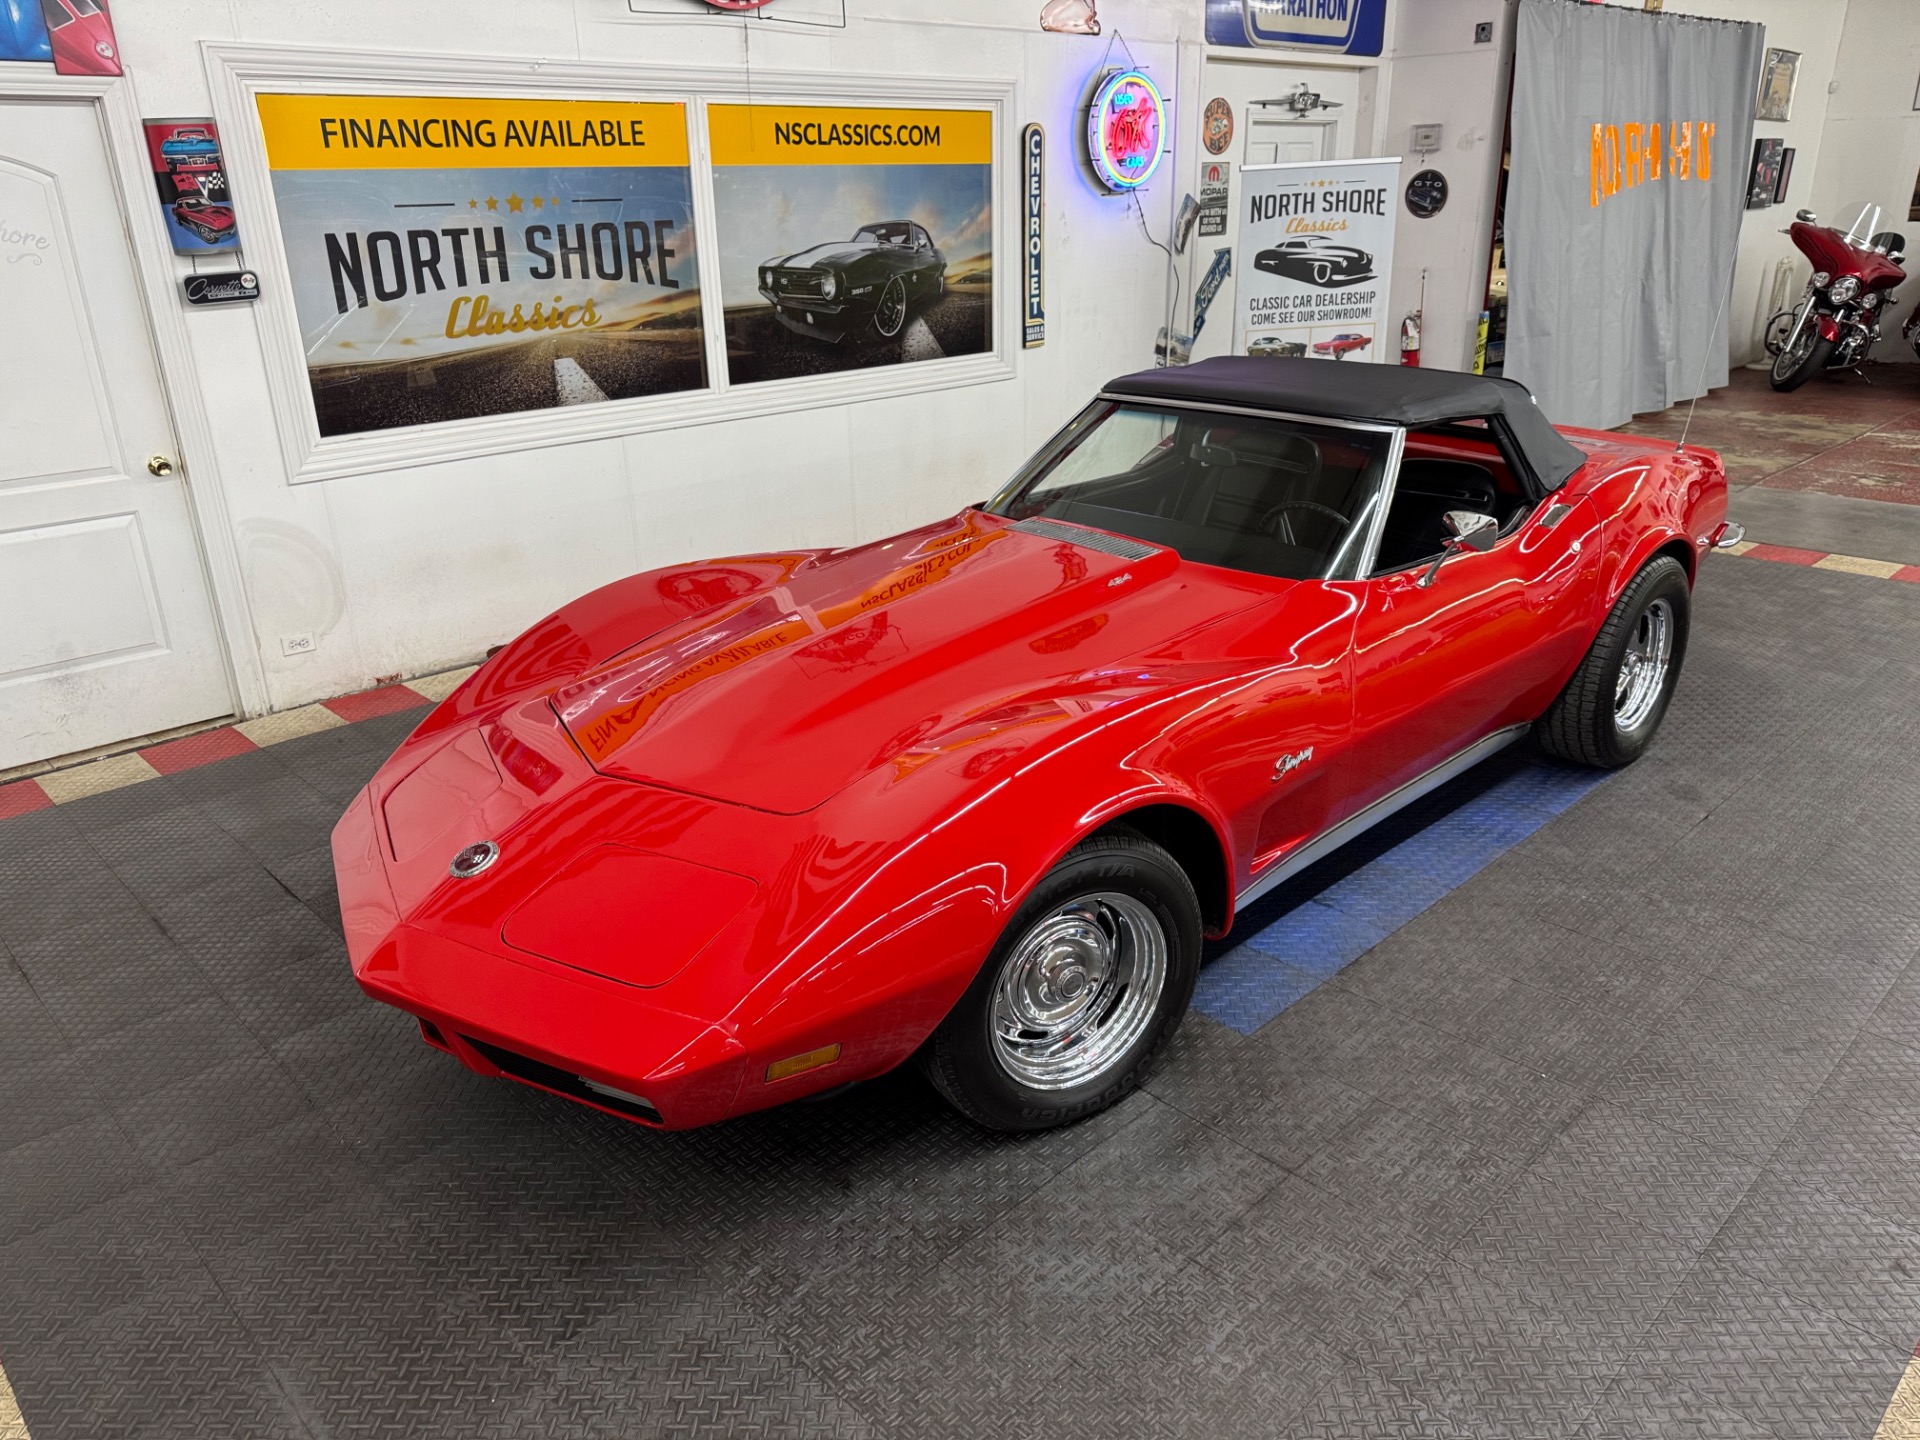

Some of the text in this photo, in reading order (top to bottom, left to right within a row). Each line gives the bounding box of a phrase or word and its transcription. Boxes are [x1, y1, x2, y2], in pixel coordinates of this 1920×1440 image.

[320, 118, 646, 149] FINANCING AVAILABLE
[774, 122, 941, 147] NSCLASSICS.COM
[1209, 131, 1229, 152] BEE
[1414, 180, 1442, 188] GTO
[1250, 188, 1387, 223] NORTH SHORE
[1030, 134, 1041, 315] CHEVROLET
[1285, 217, 1349, 234] Classics
[324, 219, 680, 315] NORTH SHORE
[187, 278, 243, 300] Corvette
[1200, 267, 1222, 308] Ford
[1249, 291, 1376, 312] CLASSIC CAR DEALERSHIP
[445, 295, 603, 339] Classics
[1251, 307, 1372, 326] COME SEE OUR SHOWROOM!
[1271, 745, 1314, 781] Stingray
